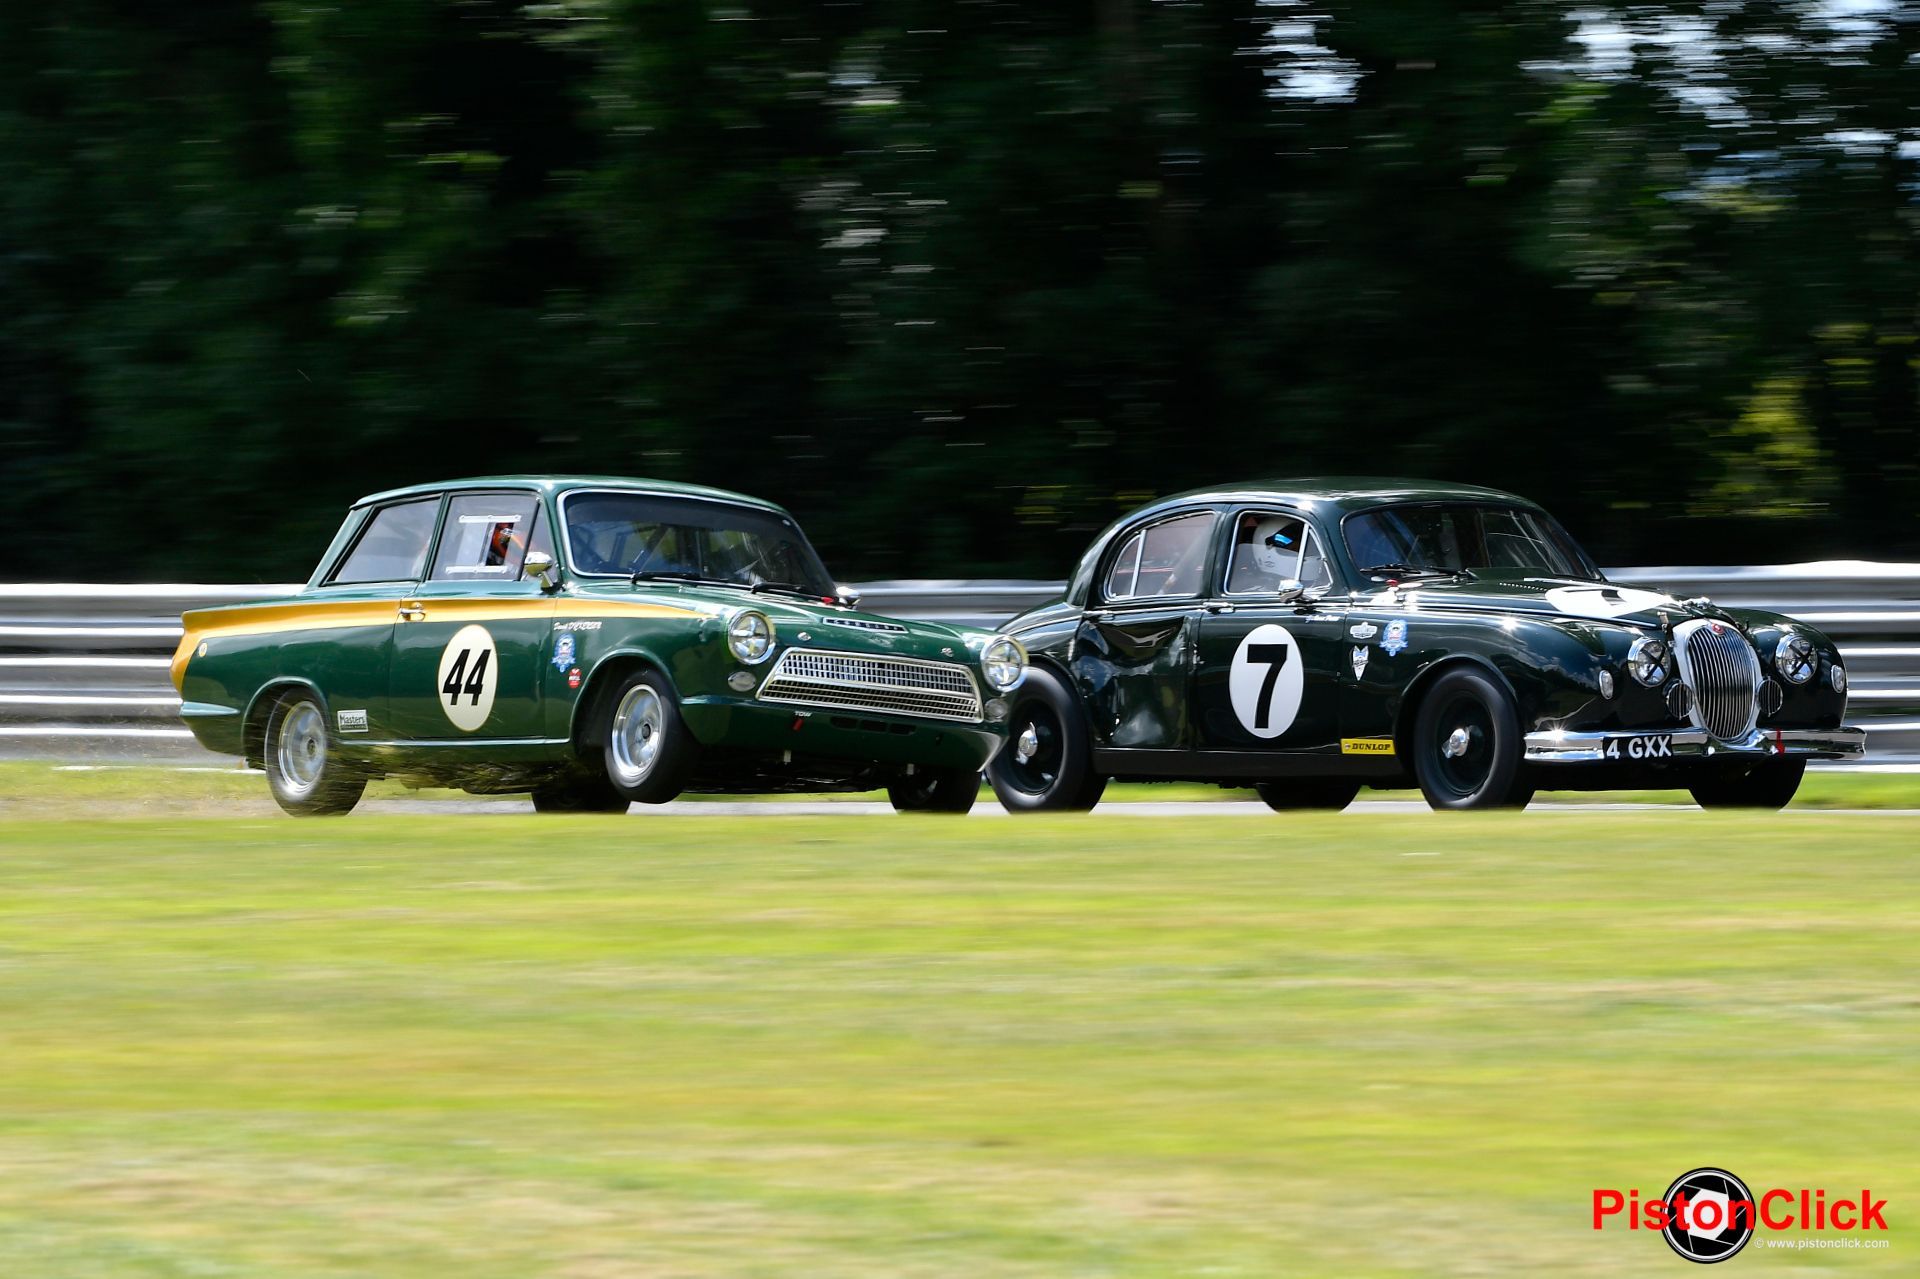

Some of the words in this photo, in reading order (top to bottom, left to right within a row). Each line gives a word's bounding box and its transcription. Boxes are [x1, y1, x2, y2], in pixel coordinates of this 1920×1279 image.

[443, 649, 491, 706] 44
[1246, 644, 1288, 729] 7
[1607, 739, 1620, 759] 4
[1628, 736, 1672, 758] GXX
